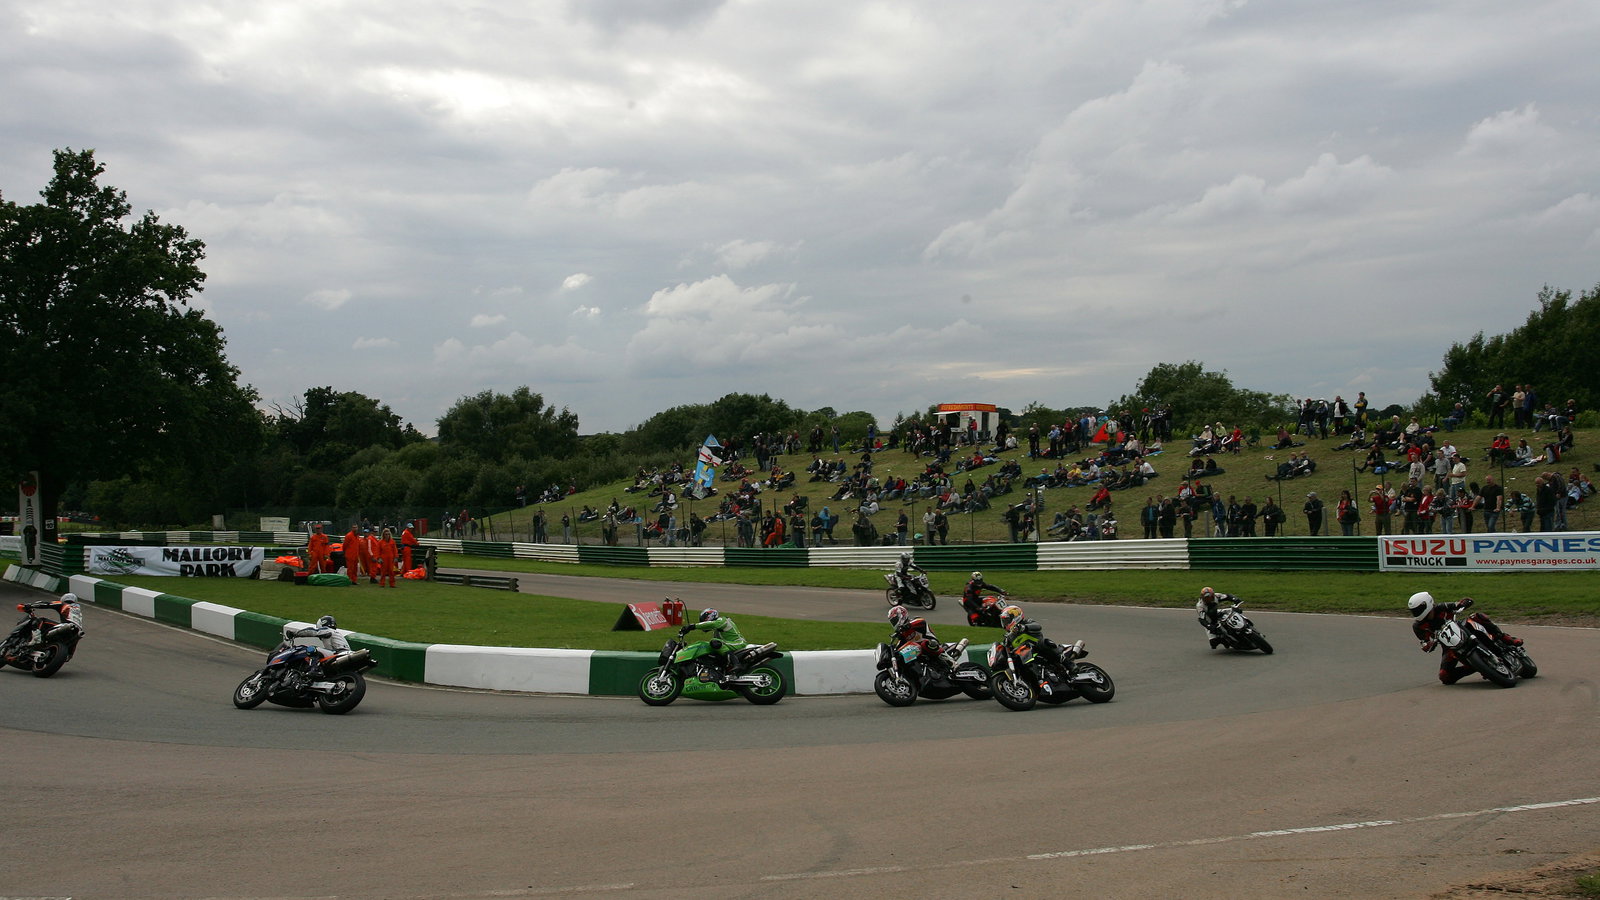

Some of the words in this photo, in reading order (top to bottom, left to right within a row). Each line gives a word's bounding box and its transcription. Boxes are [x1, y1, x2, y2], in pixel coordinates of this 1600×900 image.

[162, 546, 253, 562] MALLORY
[1385, 539, 1466, 555] ISUZU
[1406, 557, 1443, 566] TRUCK
[1475, 557, 1597, 566] www.paynesgarages.co.uk
[180, 564, 237, 577] PARK
[1441, 624, 1454, 643] 27
